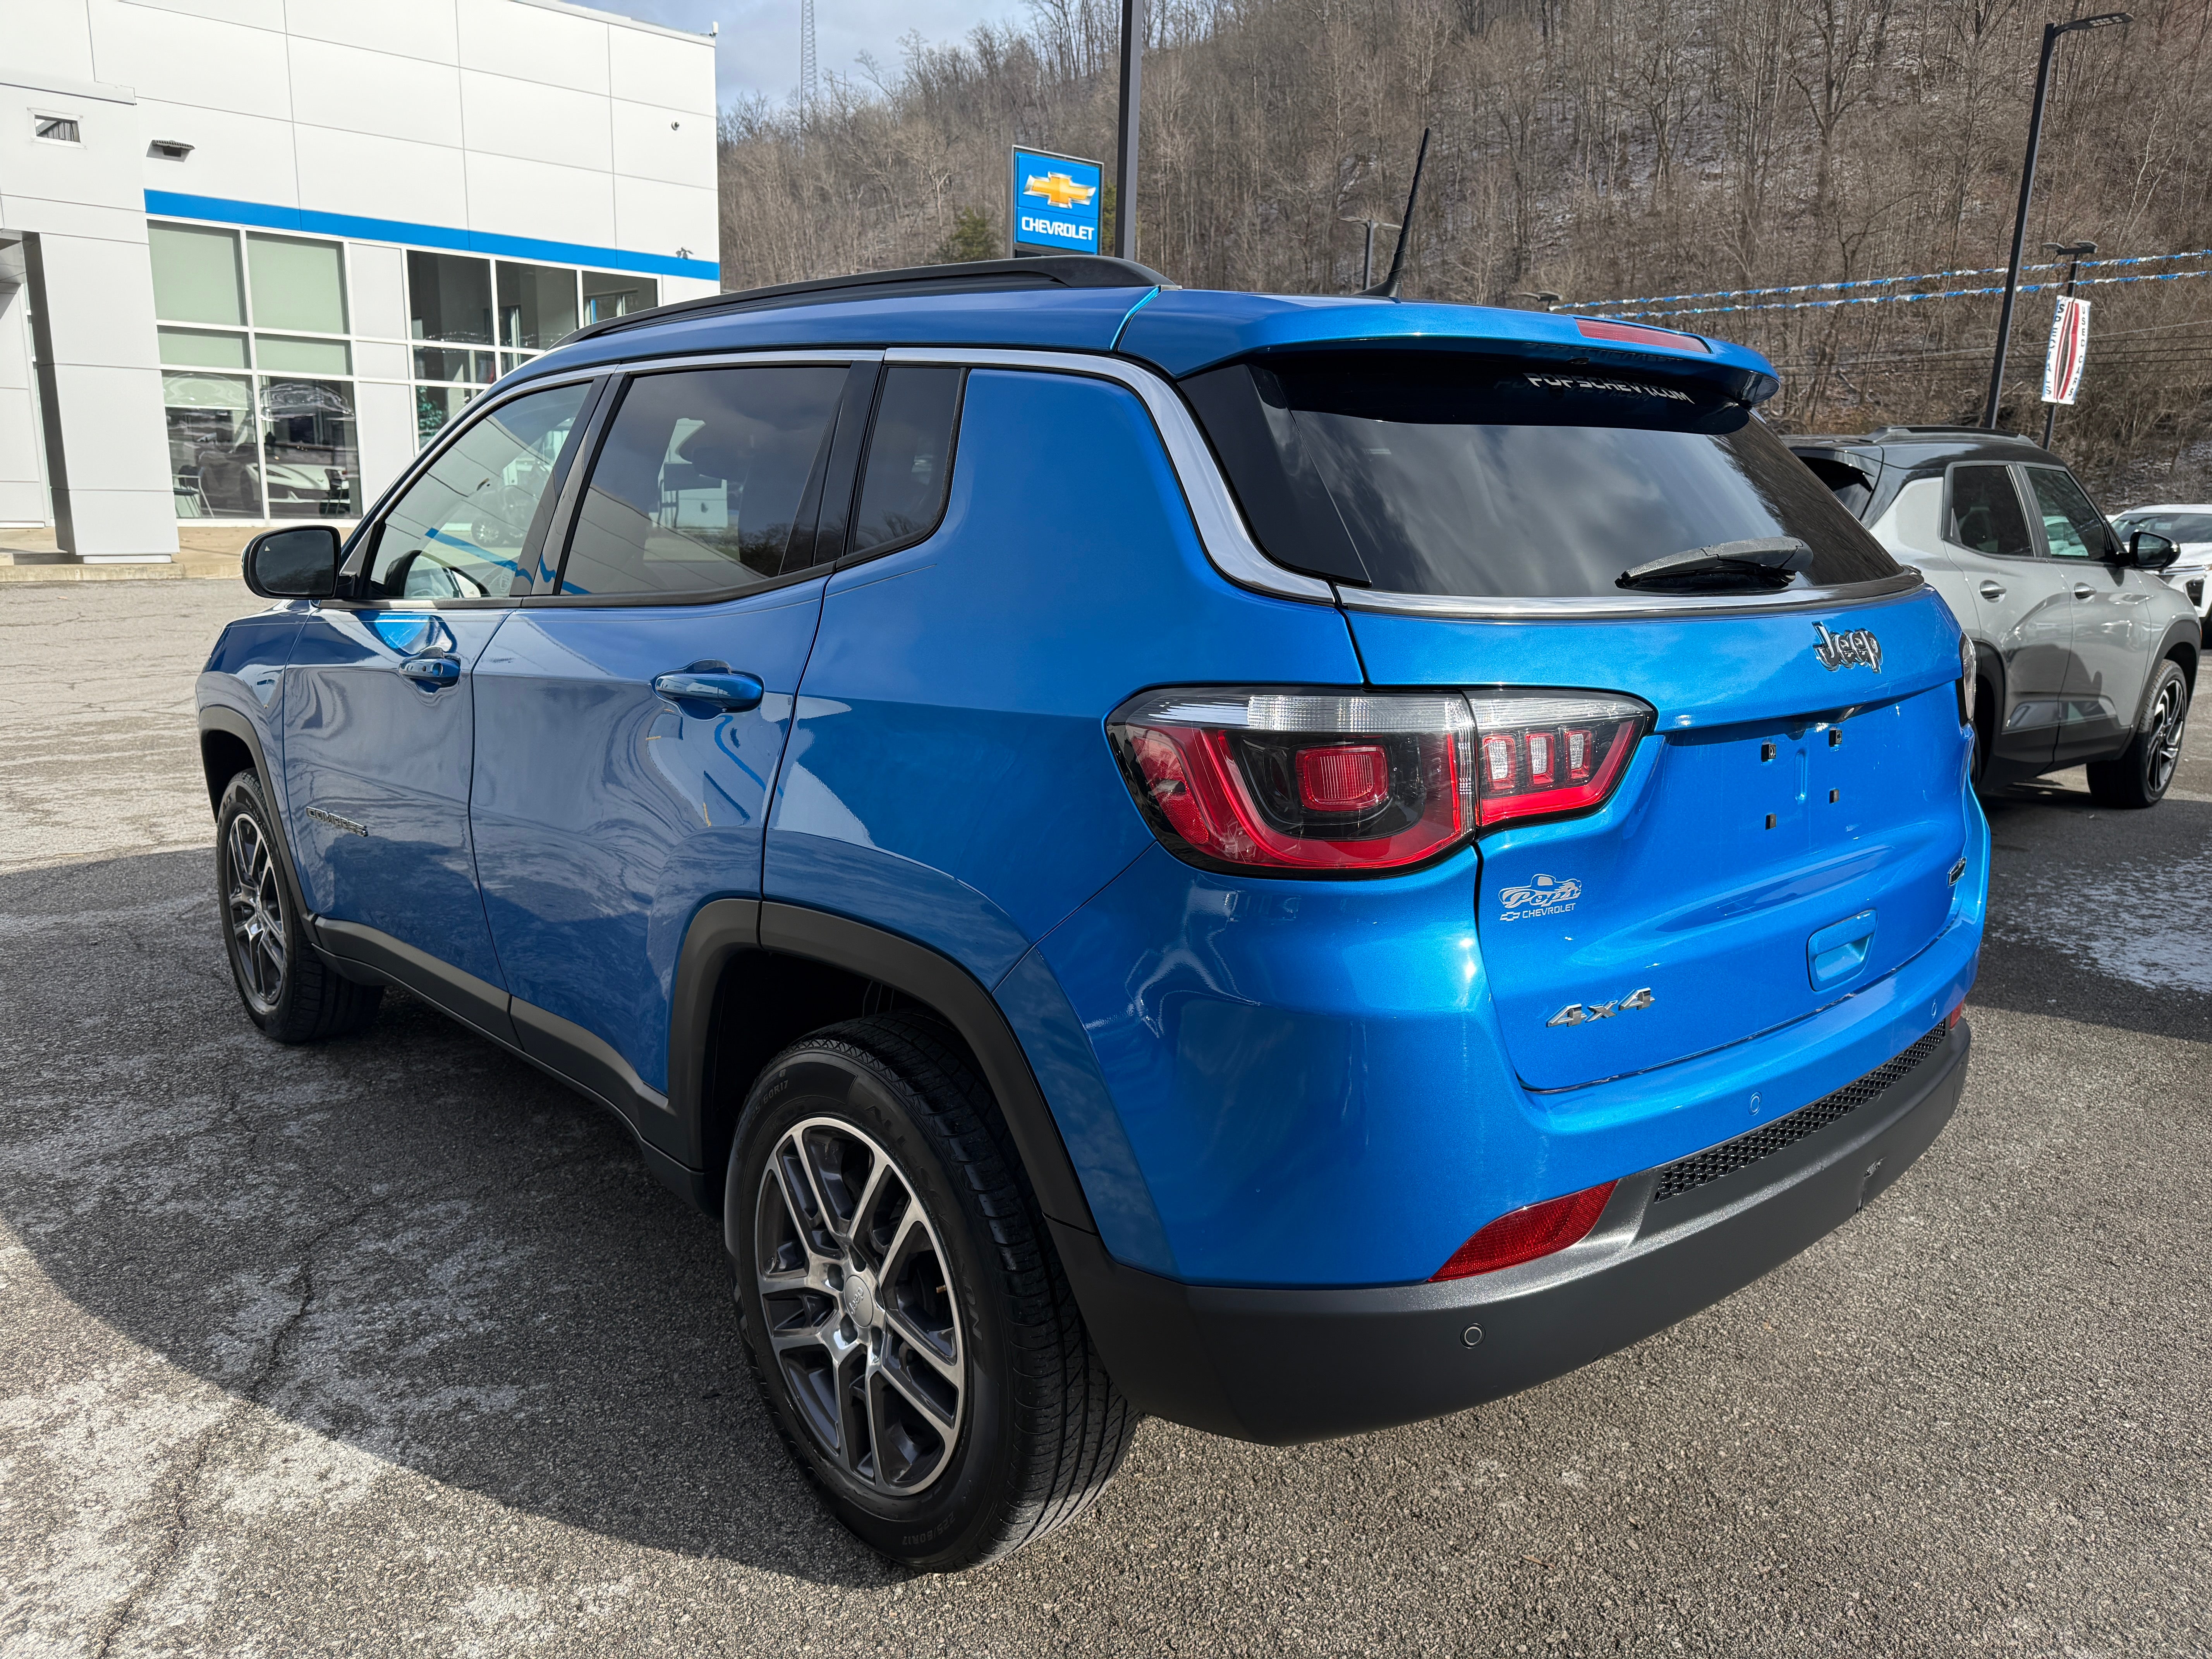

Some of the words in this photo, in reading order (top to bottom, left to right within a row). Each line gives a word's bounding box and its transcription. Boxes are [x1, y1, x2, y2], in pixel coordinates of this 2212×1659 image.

[1021, 216, 1095, 240] CHEVROLET
[1522, 373, 1696, 404] POPSCHEVY.COM
[2068, 355, 2083, 396] CARS
[1811, 620, 1884, 674] Jeep
[1522, 903, 1576, 919] CHEVROLET
[849, 1286, 864, 1316] Jeep
